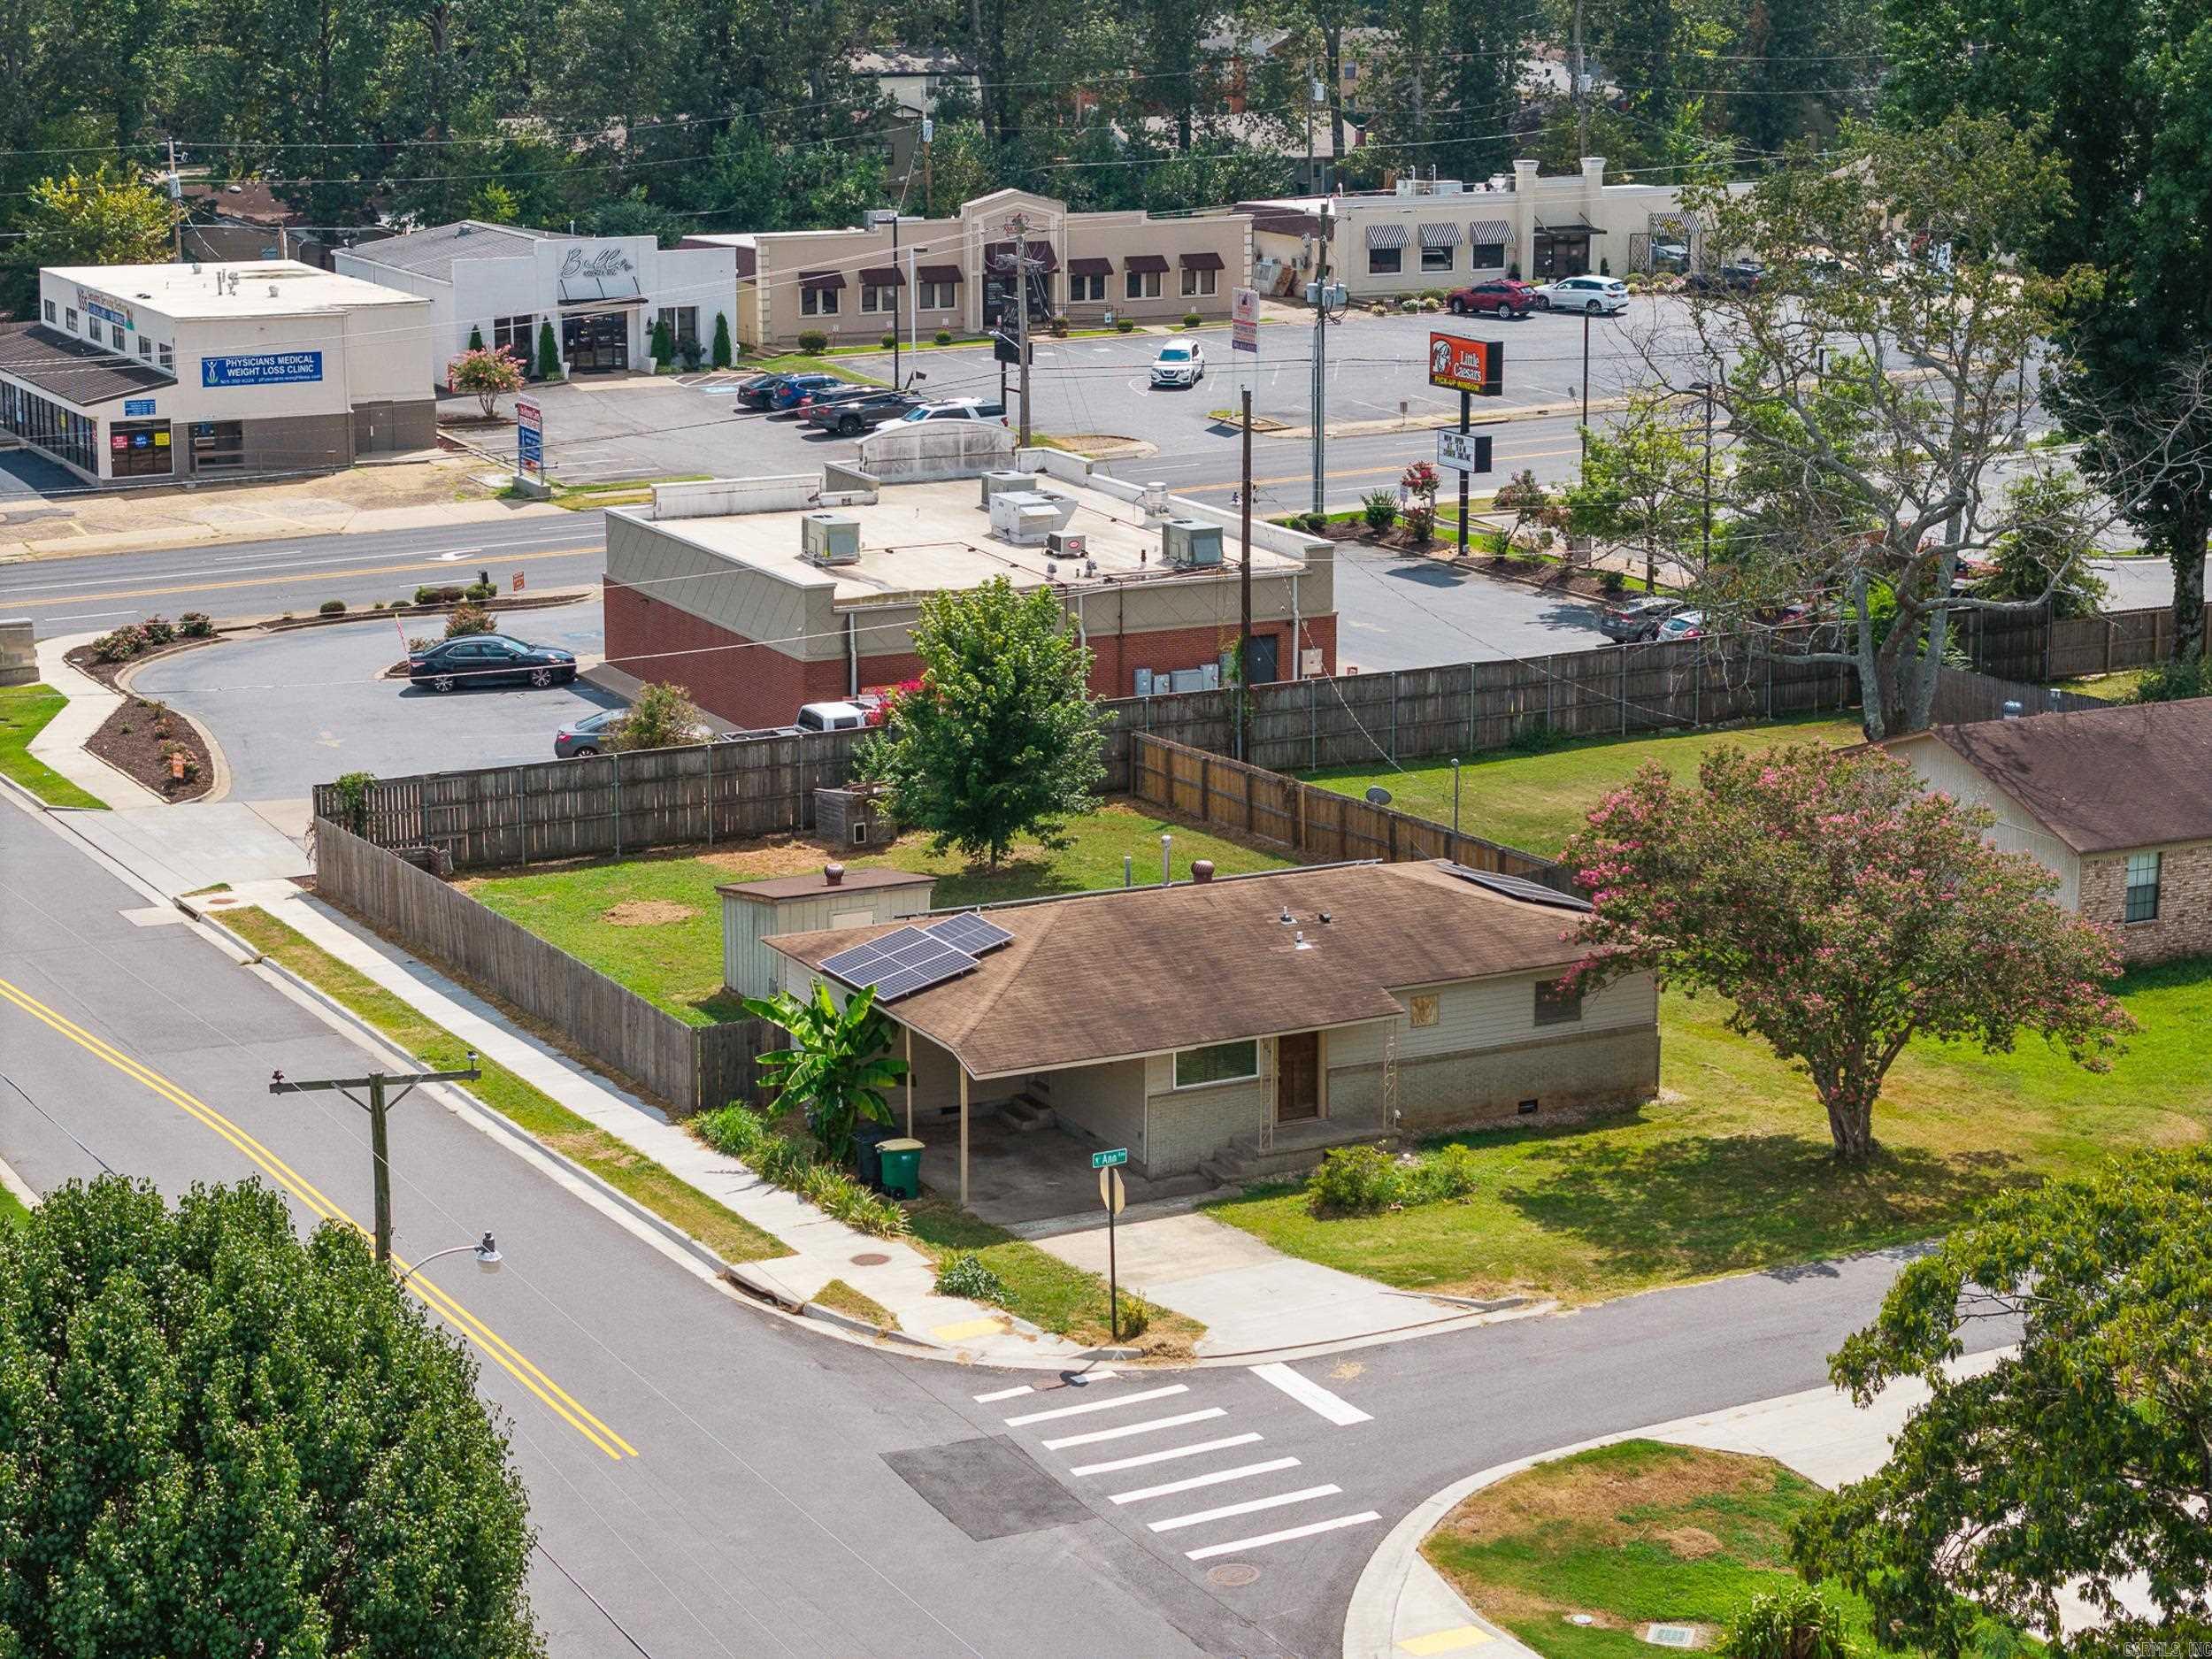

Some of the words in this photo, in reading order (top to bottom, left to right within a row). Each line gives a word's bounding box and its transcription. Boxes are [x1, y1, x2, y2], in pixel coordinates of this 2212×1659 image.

[226, 357, 275, 367] PHYSICIANS
[278, 355, 314, 365] MEDICAL
[1459, 350, 1479, 368] Little
[227, 366, 260, 377] WEIGHT
[263, 365, 285, 375] LOSS
[288, 365, 314, 373] CLINIC
[1453, 362, 1482, 382] Caesars
[1457, 380, 1480, 392] WINDOW
